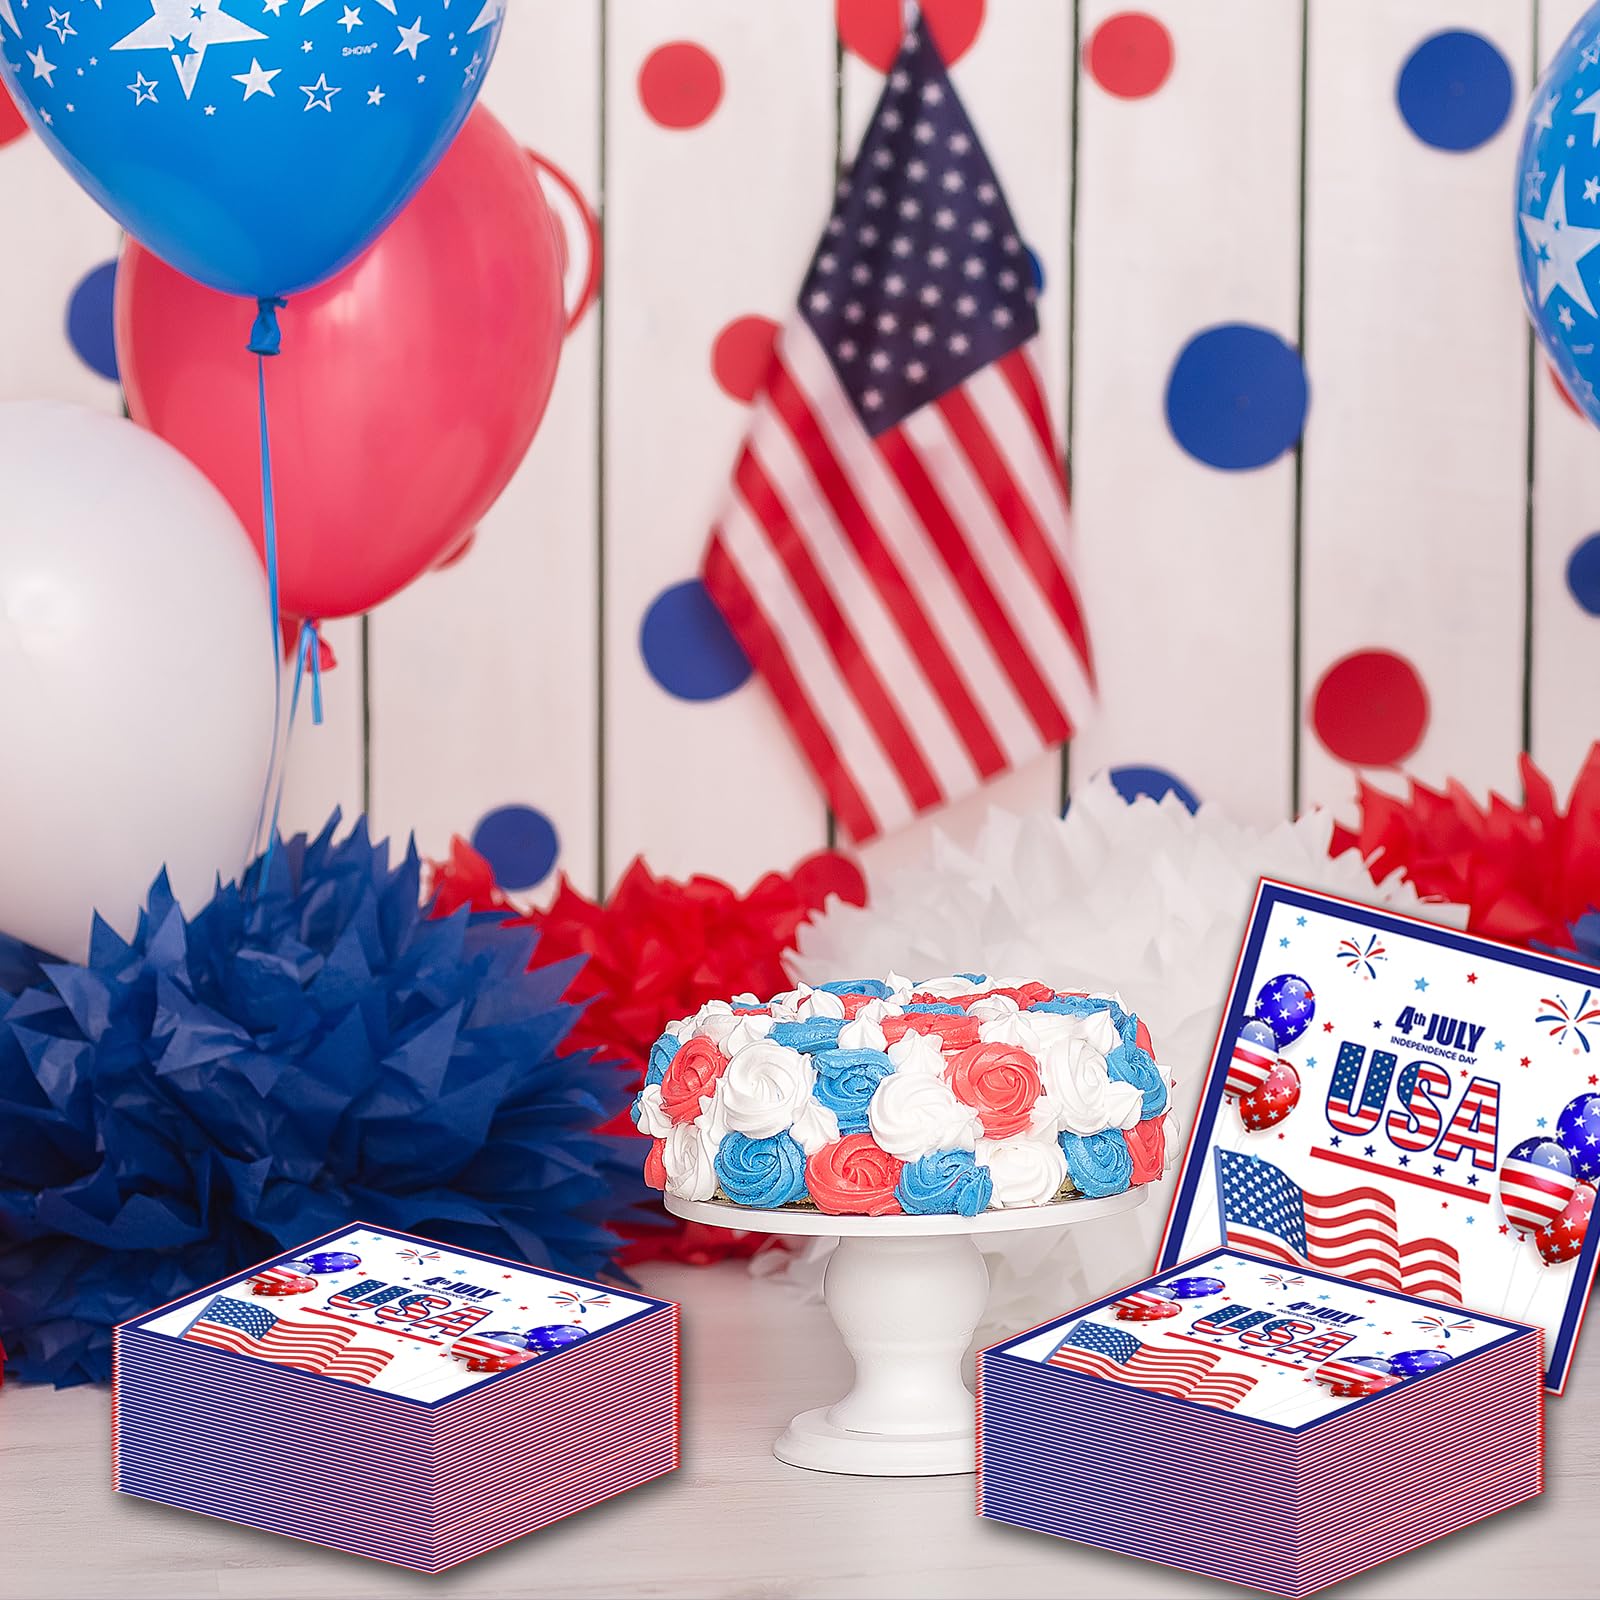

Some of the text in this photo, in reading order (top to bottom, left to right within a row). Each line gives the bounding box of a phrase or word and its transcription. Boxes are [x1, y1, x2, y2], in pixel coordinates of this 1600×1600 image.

[1395, 1006, 1486, 1053] 4th JULY
[1390, 1036, 1478, 1065] INDEPENDENCE DAY
[1325, 1040, 1501, 1172] USA
[412, 1283, 465, 1300] INDEPENDENCE
[422, 1276, 501, 1299] 4th JULY
[327, 1279, 494, 1337] USA
[1276, 1308, 1329, 1324] INDEPENDENCE
[1286, 1301, 1365, 1324] 4th JULY
[1191, 1304, 1358, 1362] USA
